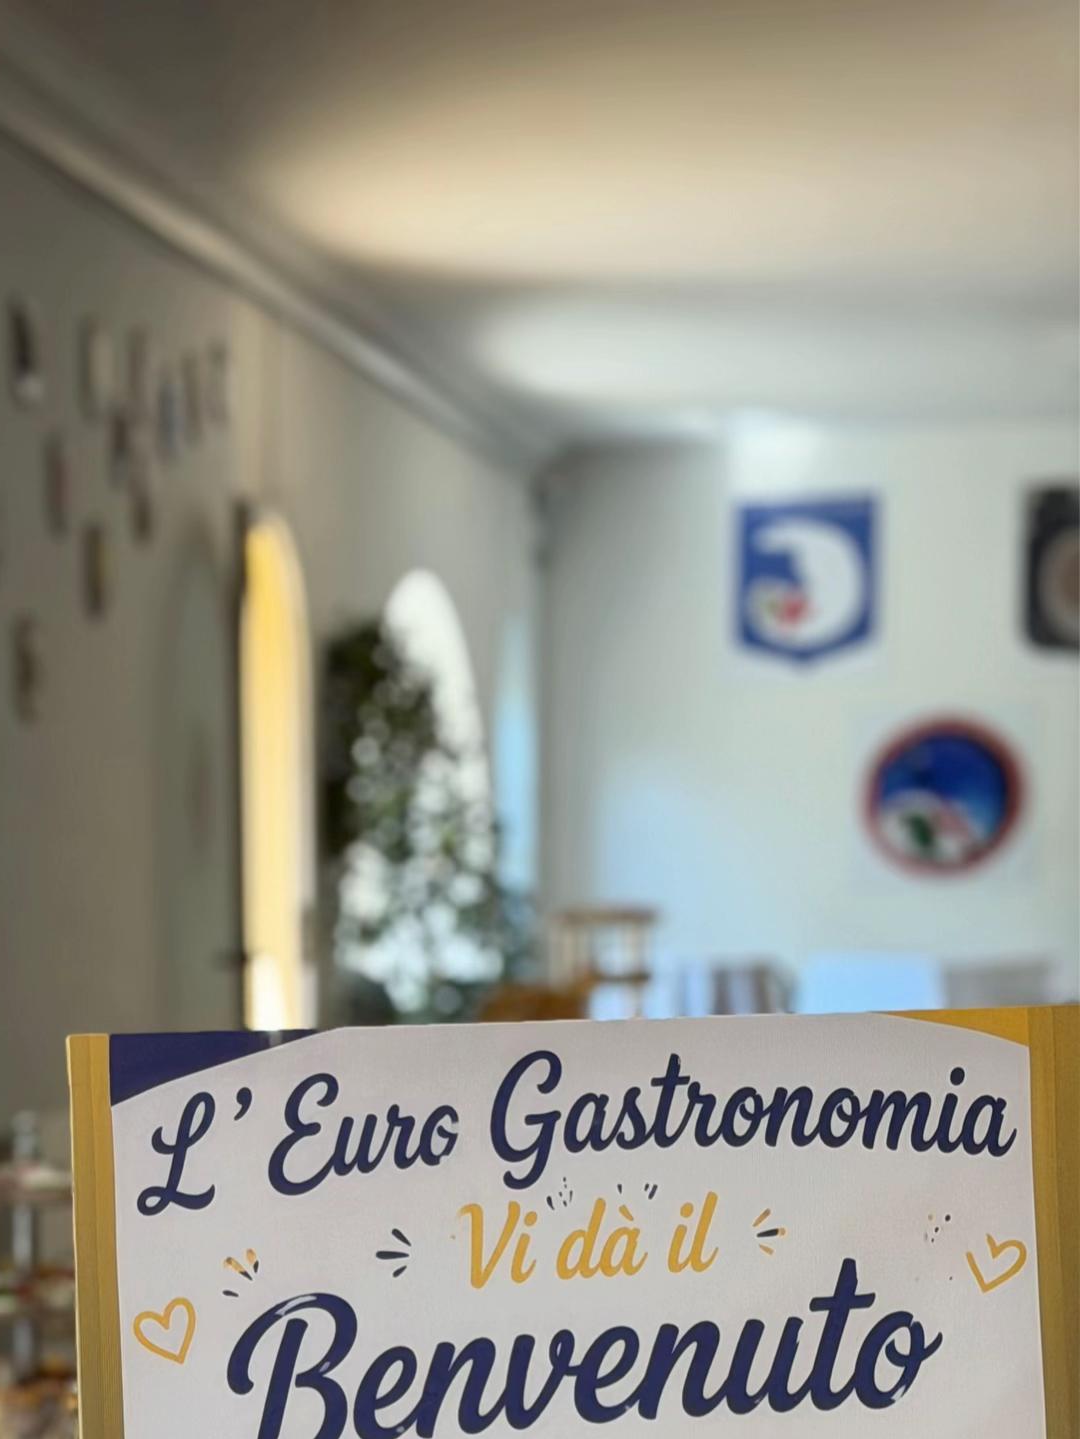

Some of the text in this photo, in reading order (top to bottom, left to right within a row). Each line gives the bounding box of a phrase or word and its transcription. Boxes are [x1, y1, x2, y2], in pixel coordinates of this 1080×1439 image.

[136, 1049, 1017, 1218] L' Euro Gastronomia
[457, 1190, 722, 1290] Vi dà il
